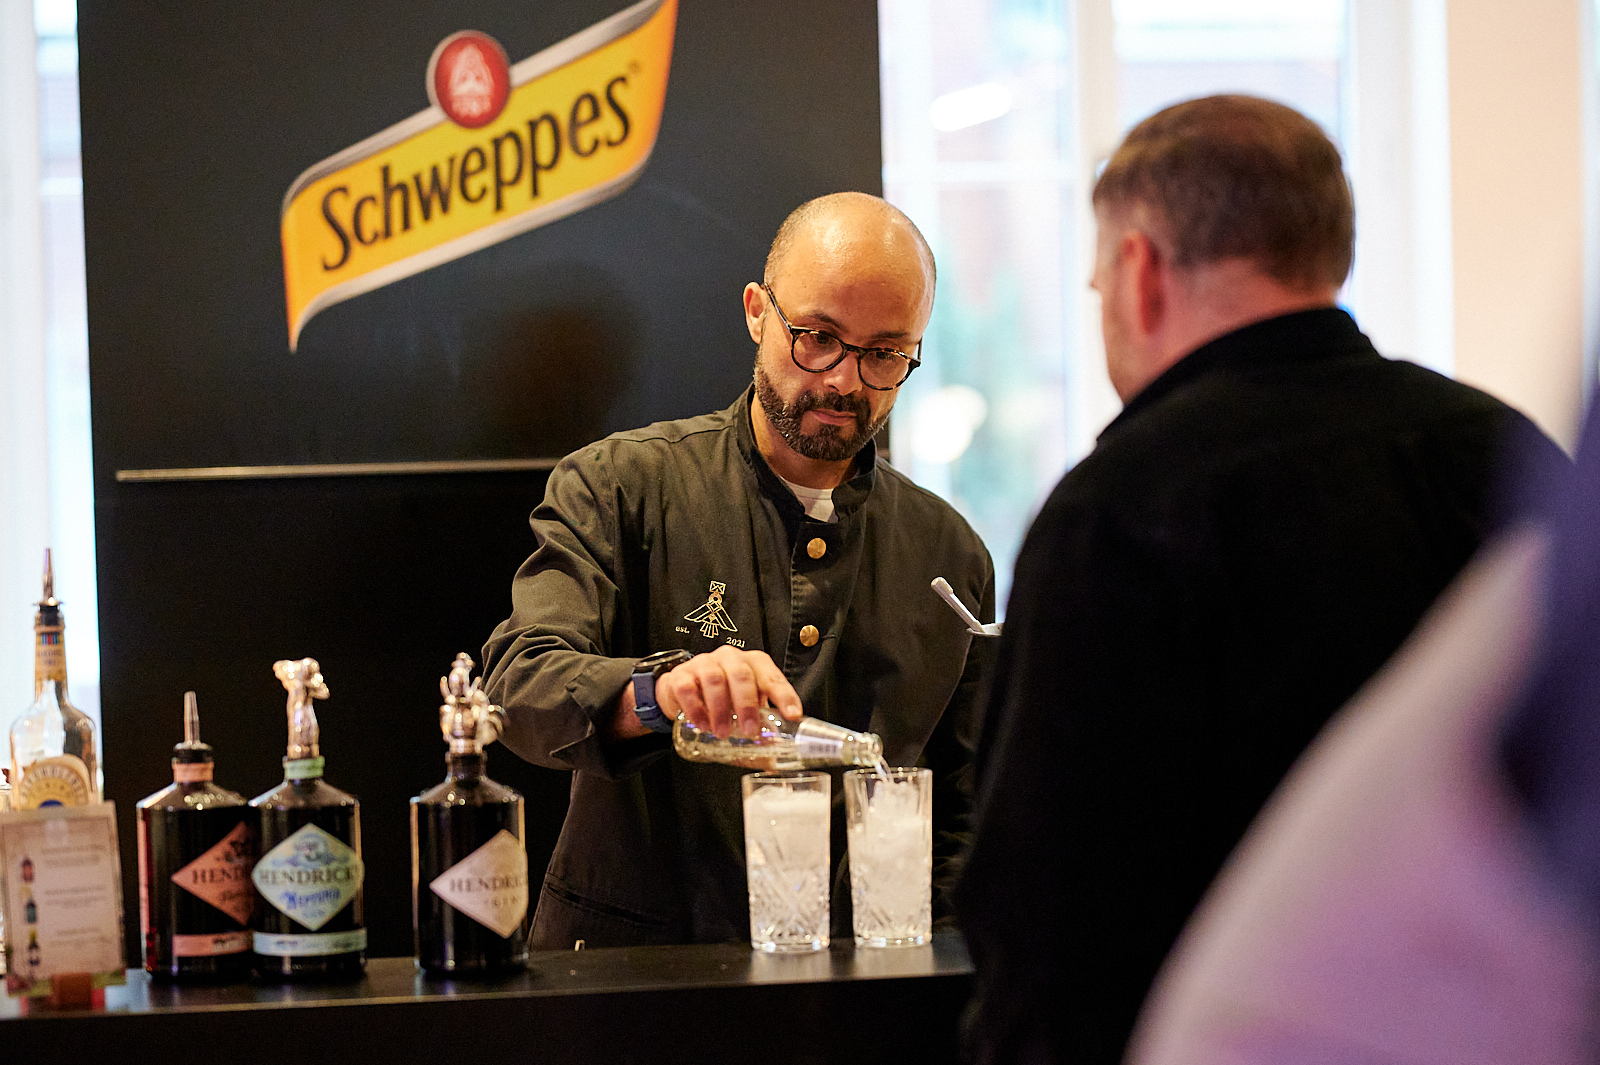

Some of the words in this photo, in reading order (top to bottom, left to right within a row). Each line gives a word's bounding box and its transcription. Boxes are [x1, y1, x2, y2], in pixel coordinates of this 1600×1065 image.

[320, 74, 632, 272] Schweppes
[675, 625, 690, 634] est.
[726, 636, 746, 648] 2021
